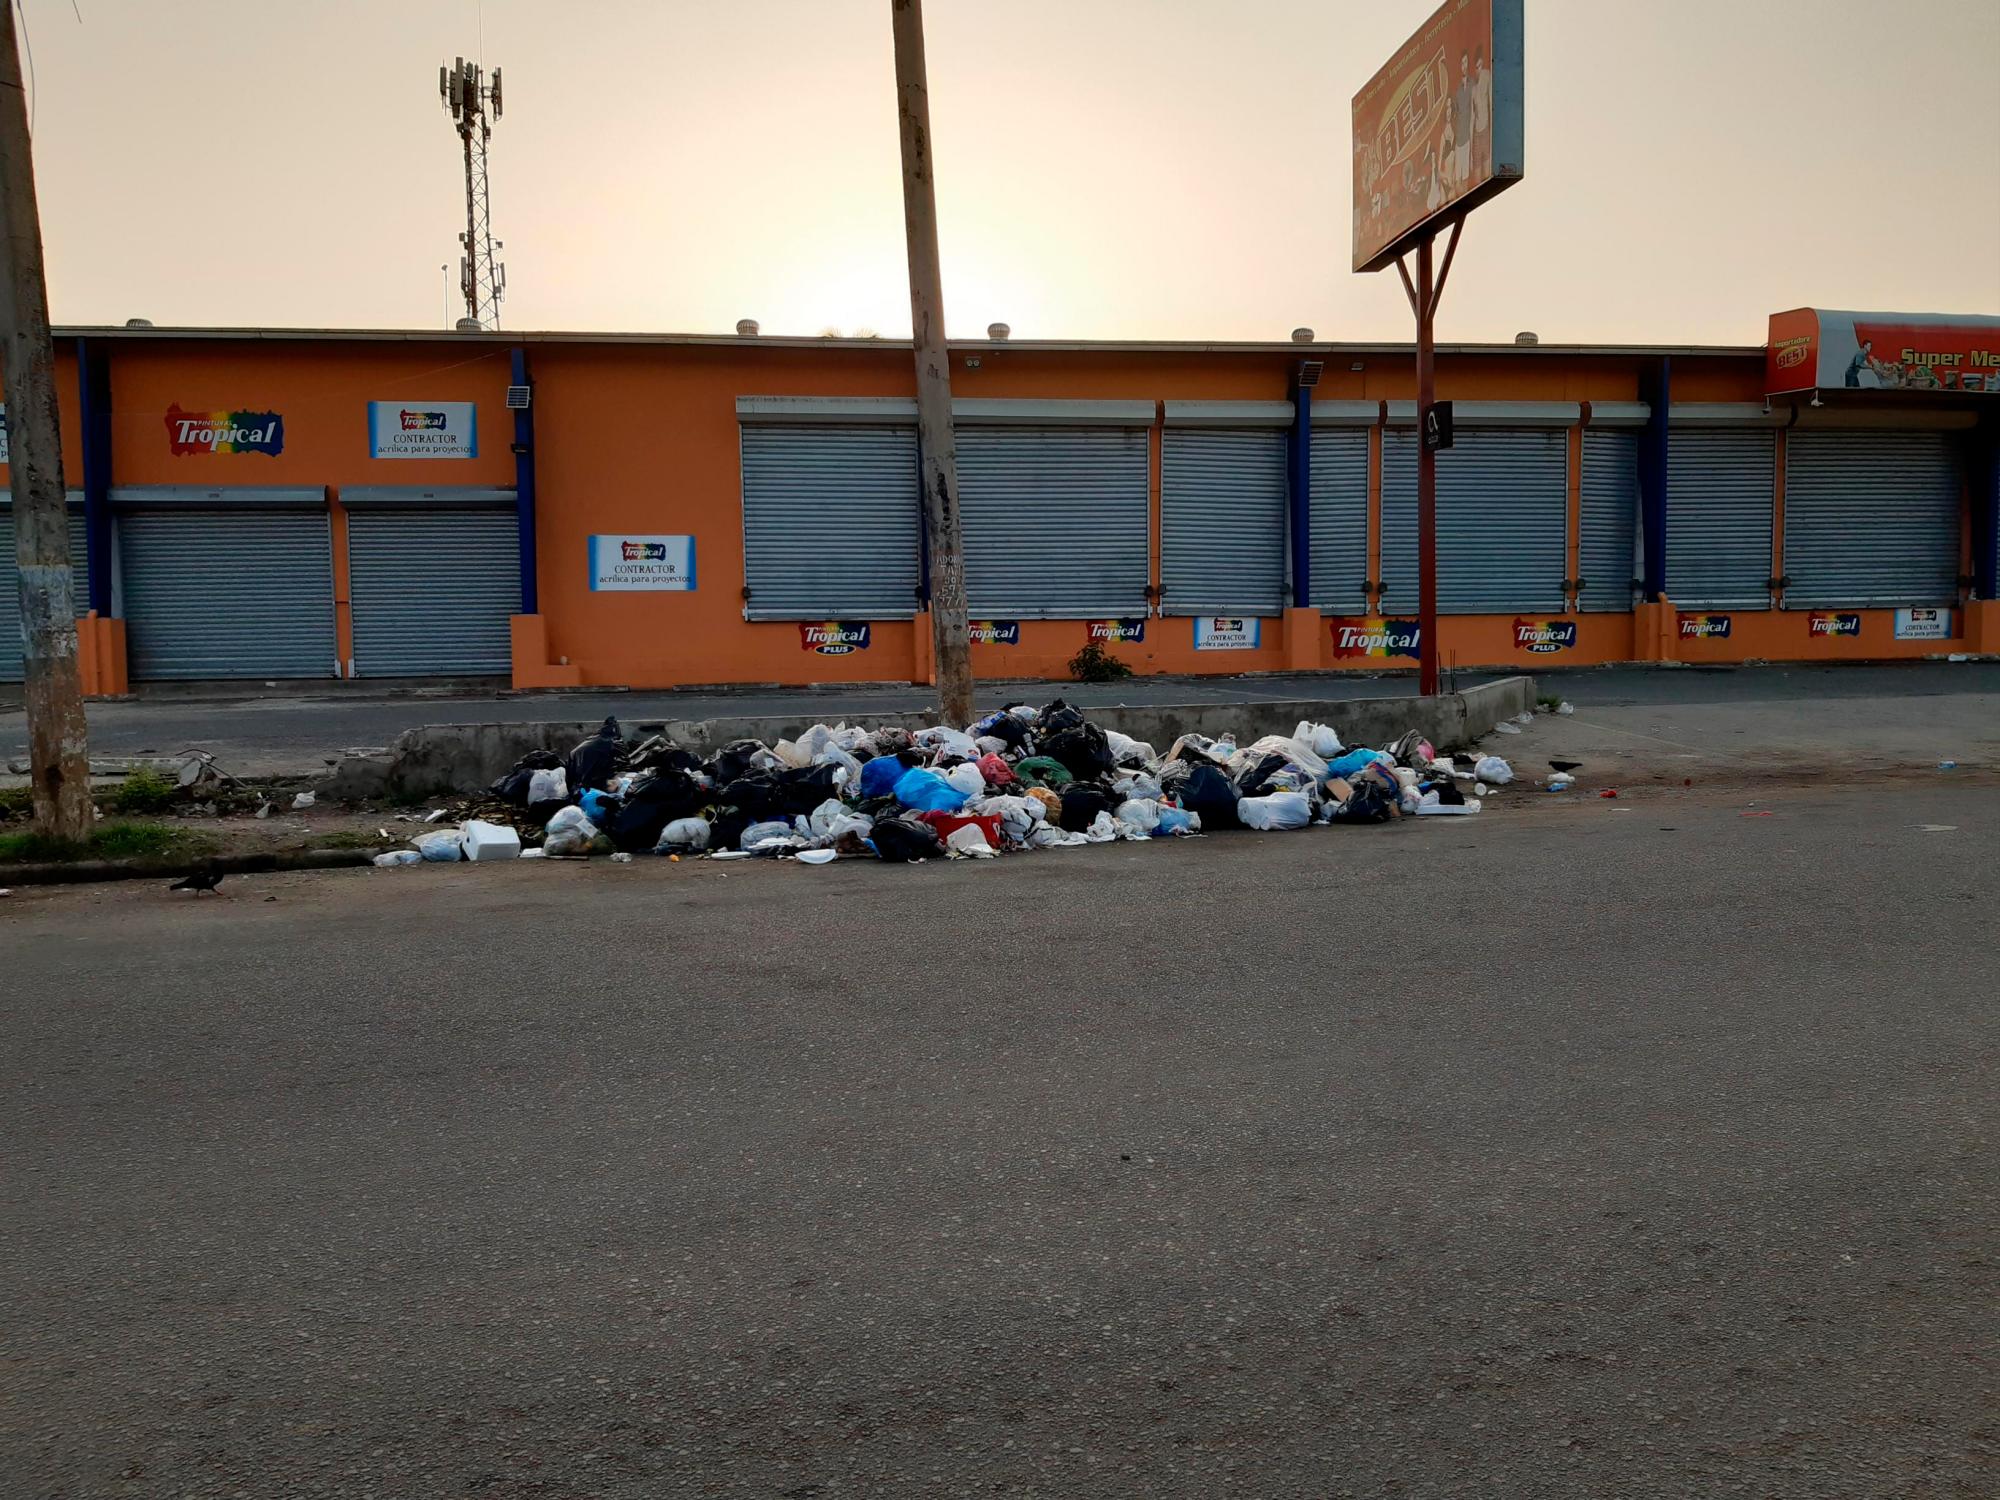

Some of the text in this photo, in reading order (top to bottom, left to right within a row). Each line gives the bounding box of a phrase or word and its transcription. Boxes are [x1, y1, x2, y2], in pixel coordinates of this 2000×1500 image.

[1379, 46, 1447, 179] BEST
[1777, 345, 1807, 369] BEST
[1902, 348, 2000, 368] Super Me
[403, 415, 443, 430] Tropical
[176, 420, 276, 451] Tropical
[393, 434, 457, 444] CONTRACTOR
[624, 546, 663, 559] Tropical
[614, 565, 676, 574] CONTRACTOR
[631, 576, 650, 584] para
[652, 576, 691, 584] proyectos
[1091, 623, 1142, 641] Tropical
[1681, 619, 1729, 637] Tropical
[1812, 617, 1858, 634] Tropical
[805, 626, 867, 644] Tropical
[1338, 626, 1421, 655] Tropical
[1517, 626, 1573, 643] Tropical
[1533, 644, 1556, 652] PLUS
